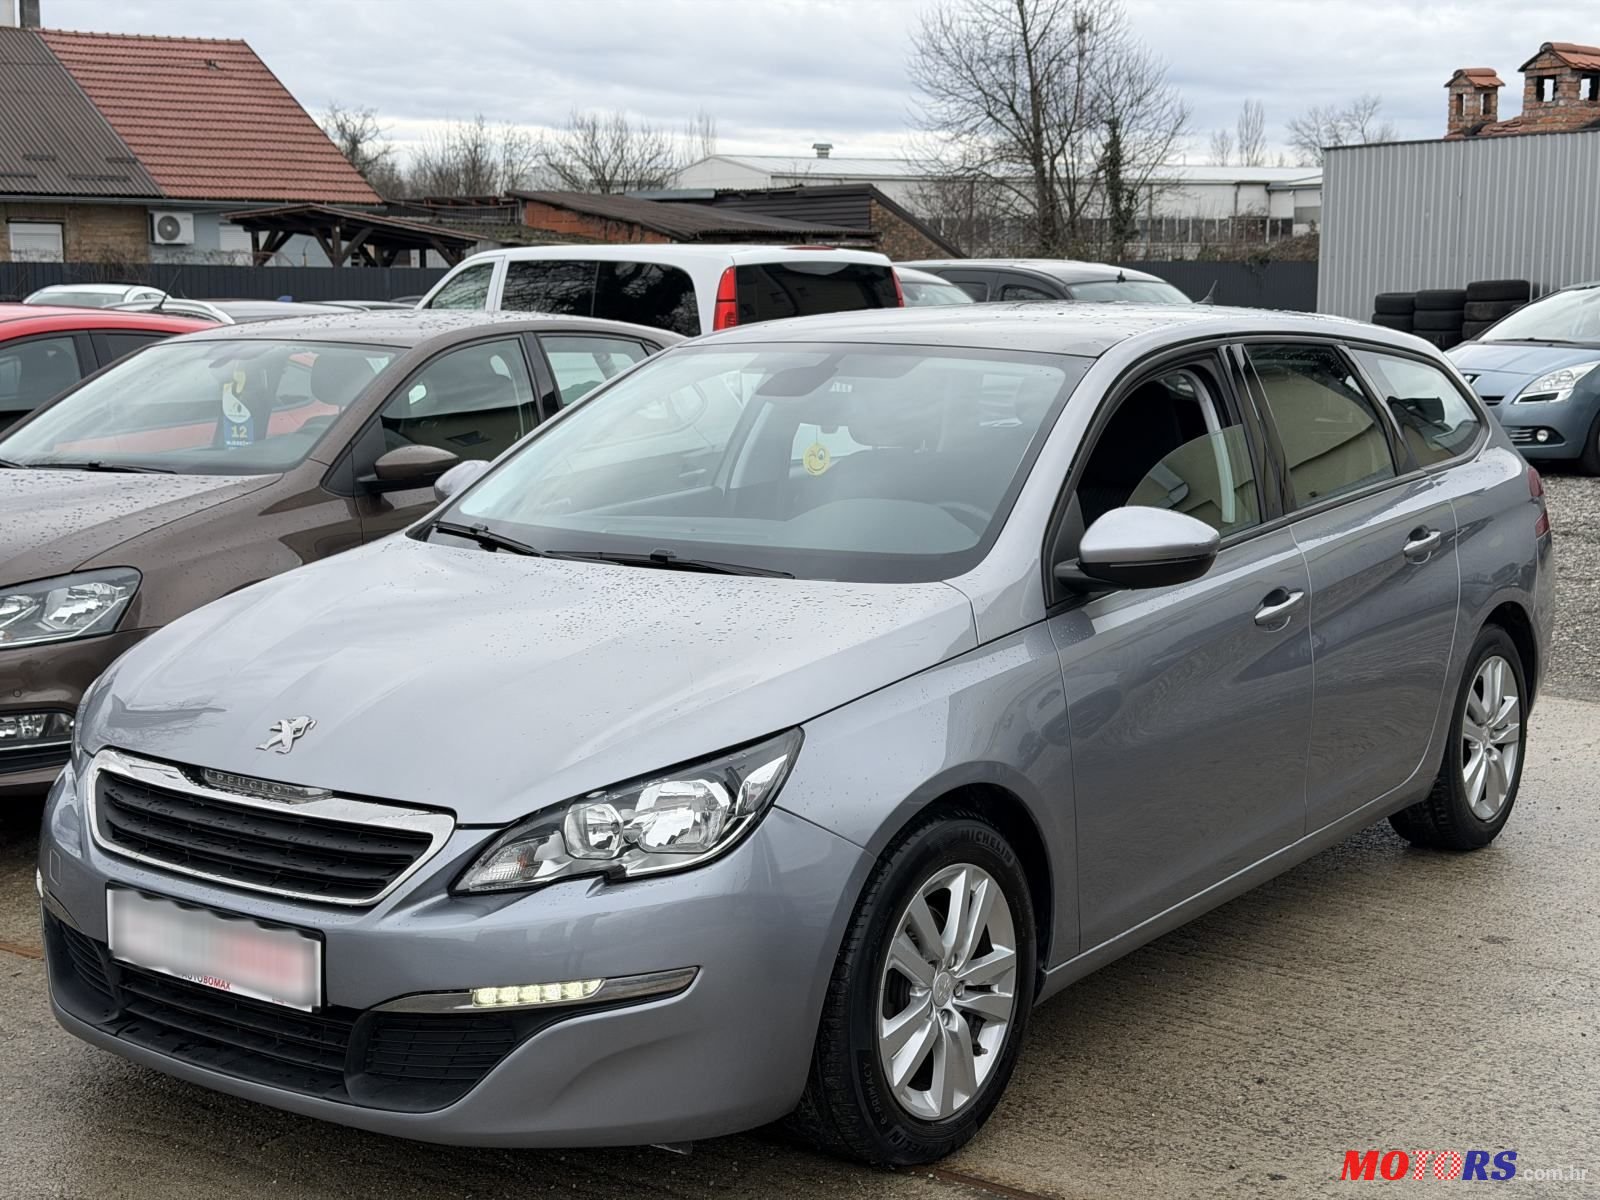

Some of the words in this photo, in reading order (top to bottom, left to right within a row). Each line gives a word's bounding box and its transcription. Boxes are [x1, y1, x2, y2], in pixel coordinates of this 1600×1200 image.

[231, 425, 248, 439] 12
[216, 774, 293, 795] PEUGEOT
[960, 829, 1013, 863] MICHELIN
